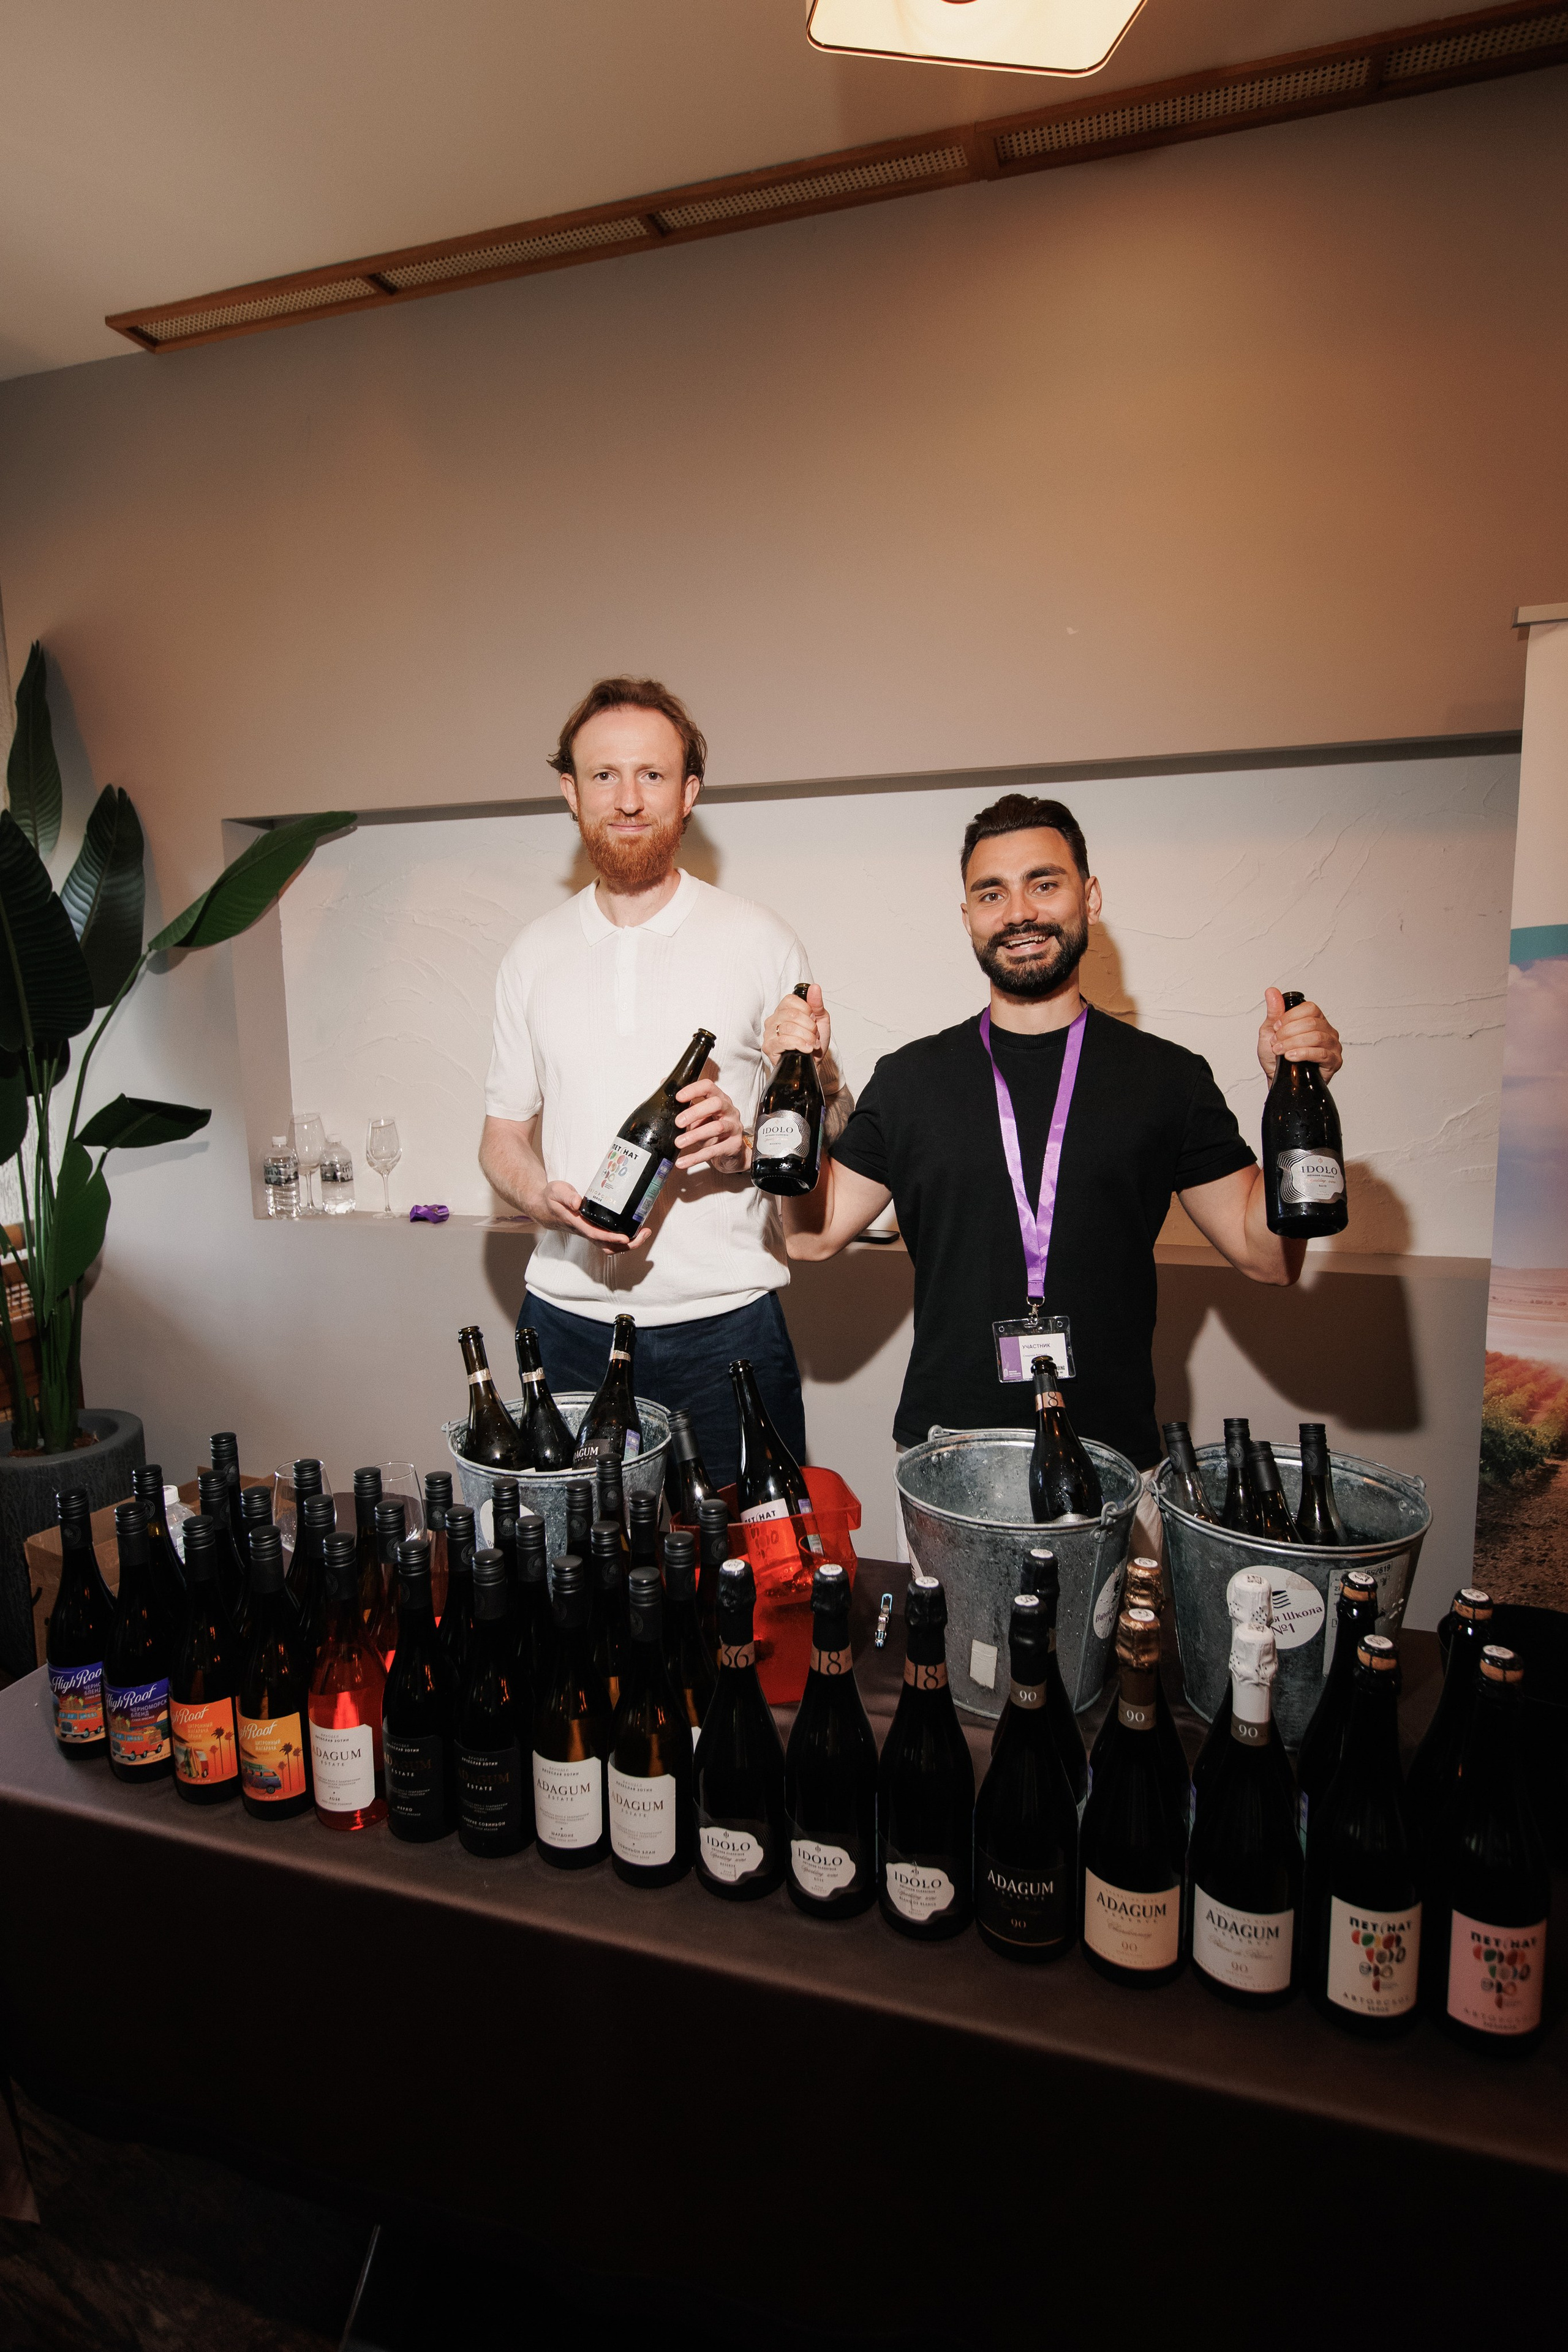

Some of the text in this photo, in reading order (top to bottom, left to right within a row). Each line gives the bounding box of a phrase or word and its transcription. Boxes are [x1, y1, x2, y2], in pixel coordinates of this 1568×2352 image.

[763, 1126, 793, 1135] IDOLO
[623, 1149, 639, 1160] НАТ
[1302, 1166, 1338, 1175] IDOLO
[759, 1510, 776, 1521] НАТ
[1282, 1606, 1324, 1621] Школа
[1272, 1623, 1296, 1636] №1
[818, 1650, 842, 1675] 18
[52, 1668, 102, 1694] High Roo
[913, 1664, 939, 1690] 18
[106, 1683, 157, 1713] High Roof
[1019, 1689, 1037, 1702] 90
[130, 1698, 168, 1713] ЧЕРНОМОРСК
[179, 1705, 210, 1725] Roof
[1126, 1709, 1145, 1722] 90
[247, 1720, 279, 1740] Roof
[1238, 1724, 1258, 1738] 90
[312, 1745, 361, 1761] ADAGUM
[391, 1768, 415, 1777] ESTATE
[537, 1778, 590, 1795] ADAGUM
[611, 1790, 664, 1811] ADAGUM
[621, 1808, 647, 1817] ESTATE
[707, 1835, 750, 1851] IDOLO
[798, 1847, 842, 1866] IDOLO
[895, 1871, 941, 1888] IDOLO
[987, 1869, 1054, 1896] ADAGUM
[1096, 1891, 1167, 1918] ADAGUM
[1011, 1918, 1027, 1929] 90
[1205, 1909, 1280, 1939] ADAGUM
[1349, 1915, 1411, 1932] ПЕТ НАТ
[1121, 1940, 1137, 1951] 90
[1471, 1931, 1536, 1948] ПЕТ НАТ
[1231, 1961, 1248, 1972] 90
